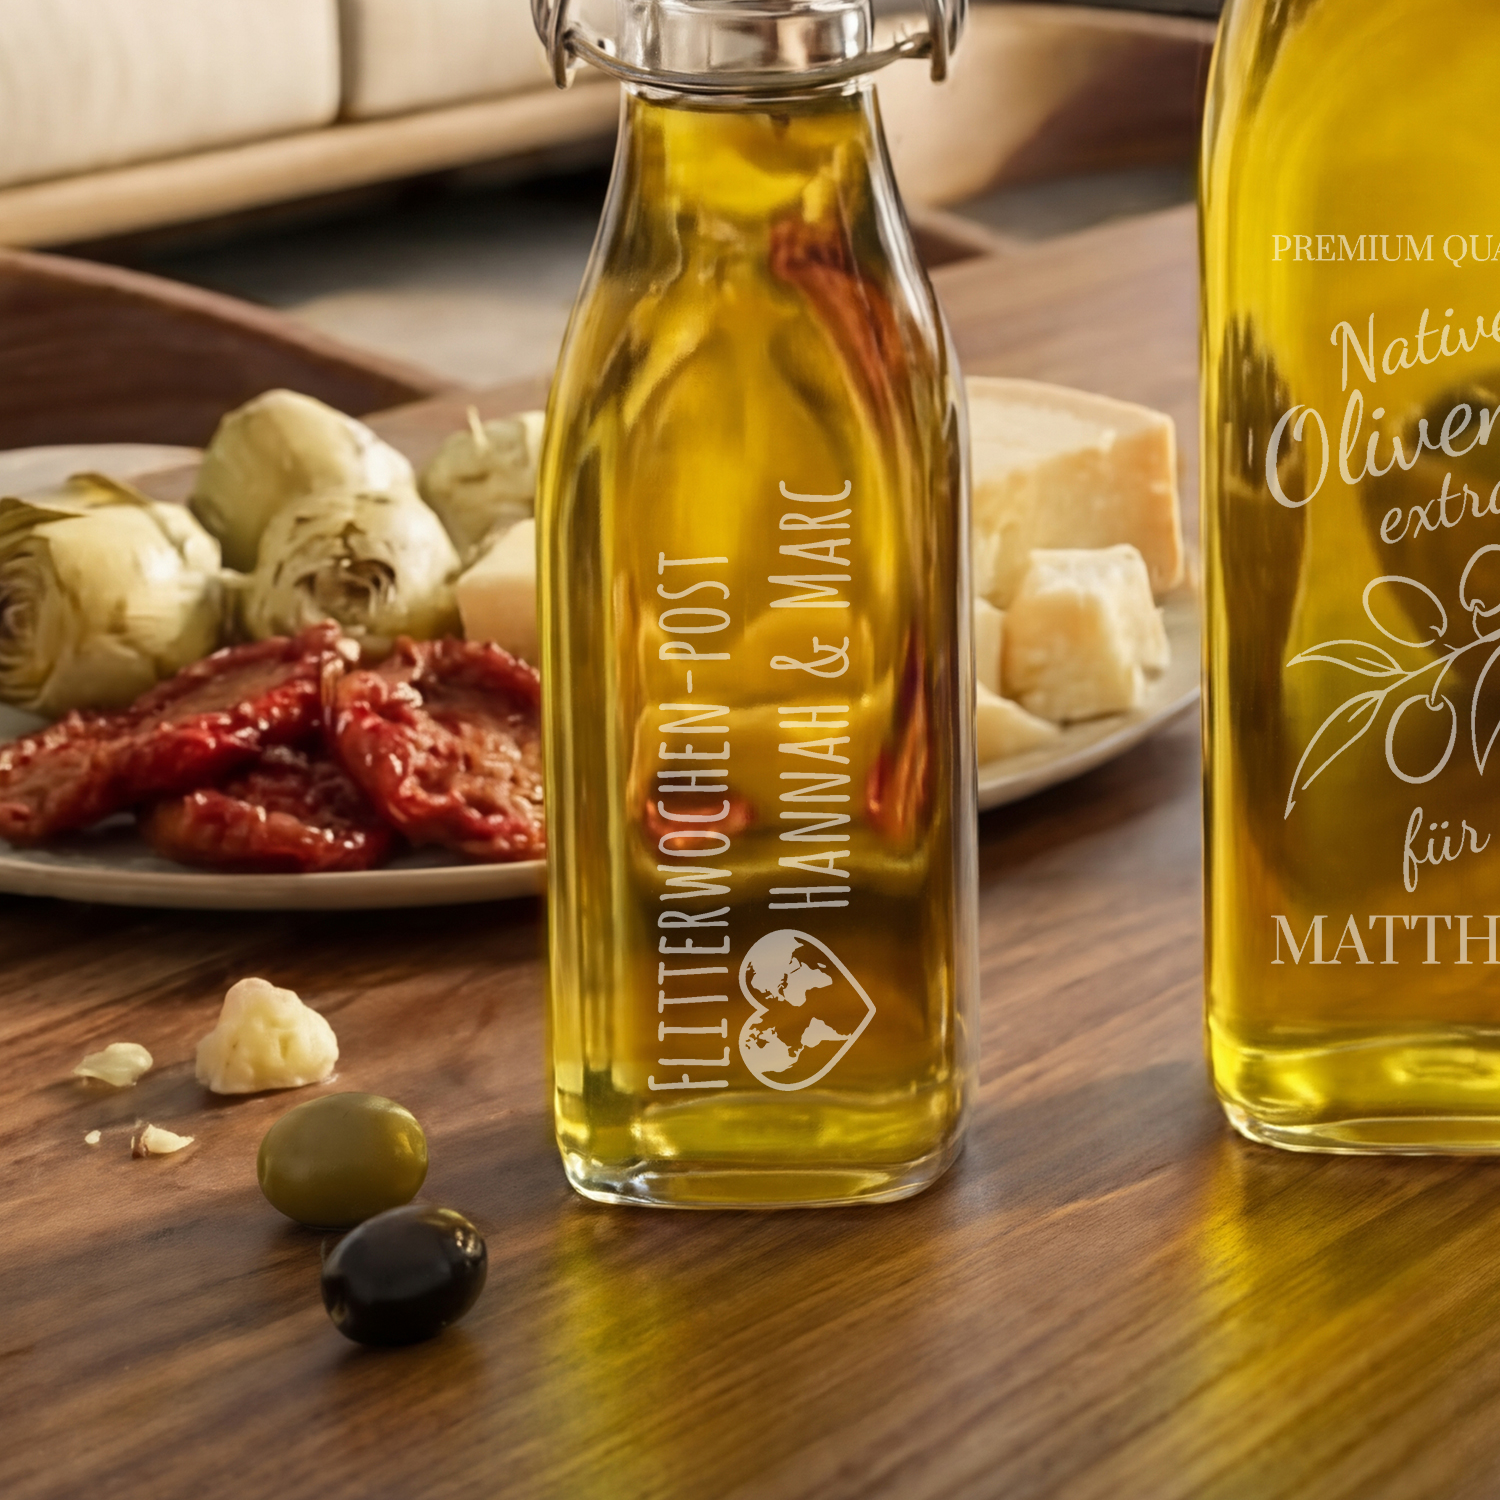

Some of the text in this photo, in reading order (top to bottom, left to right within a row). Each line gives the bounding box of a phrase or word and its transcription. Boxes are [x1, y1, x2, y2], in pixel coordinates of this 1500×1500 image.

[1272, 234, 1434, 262] PREMIUM
[648, 551, 730, 1091] FLITTERWOCHEN-POST
[768, 479, 851, 909] HANNAH & MARC
[1402, 807, 1490, 892] für
